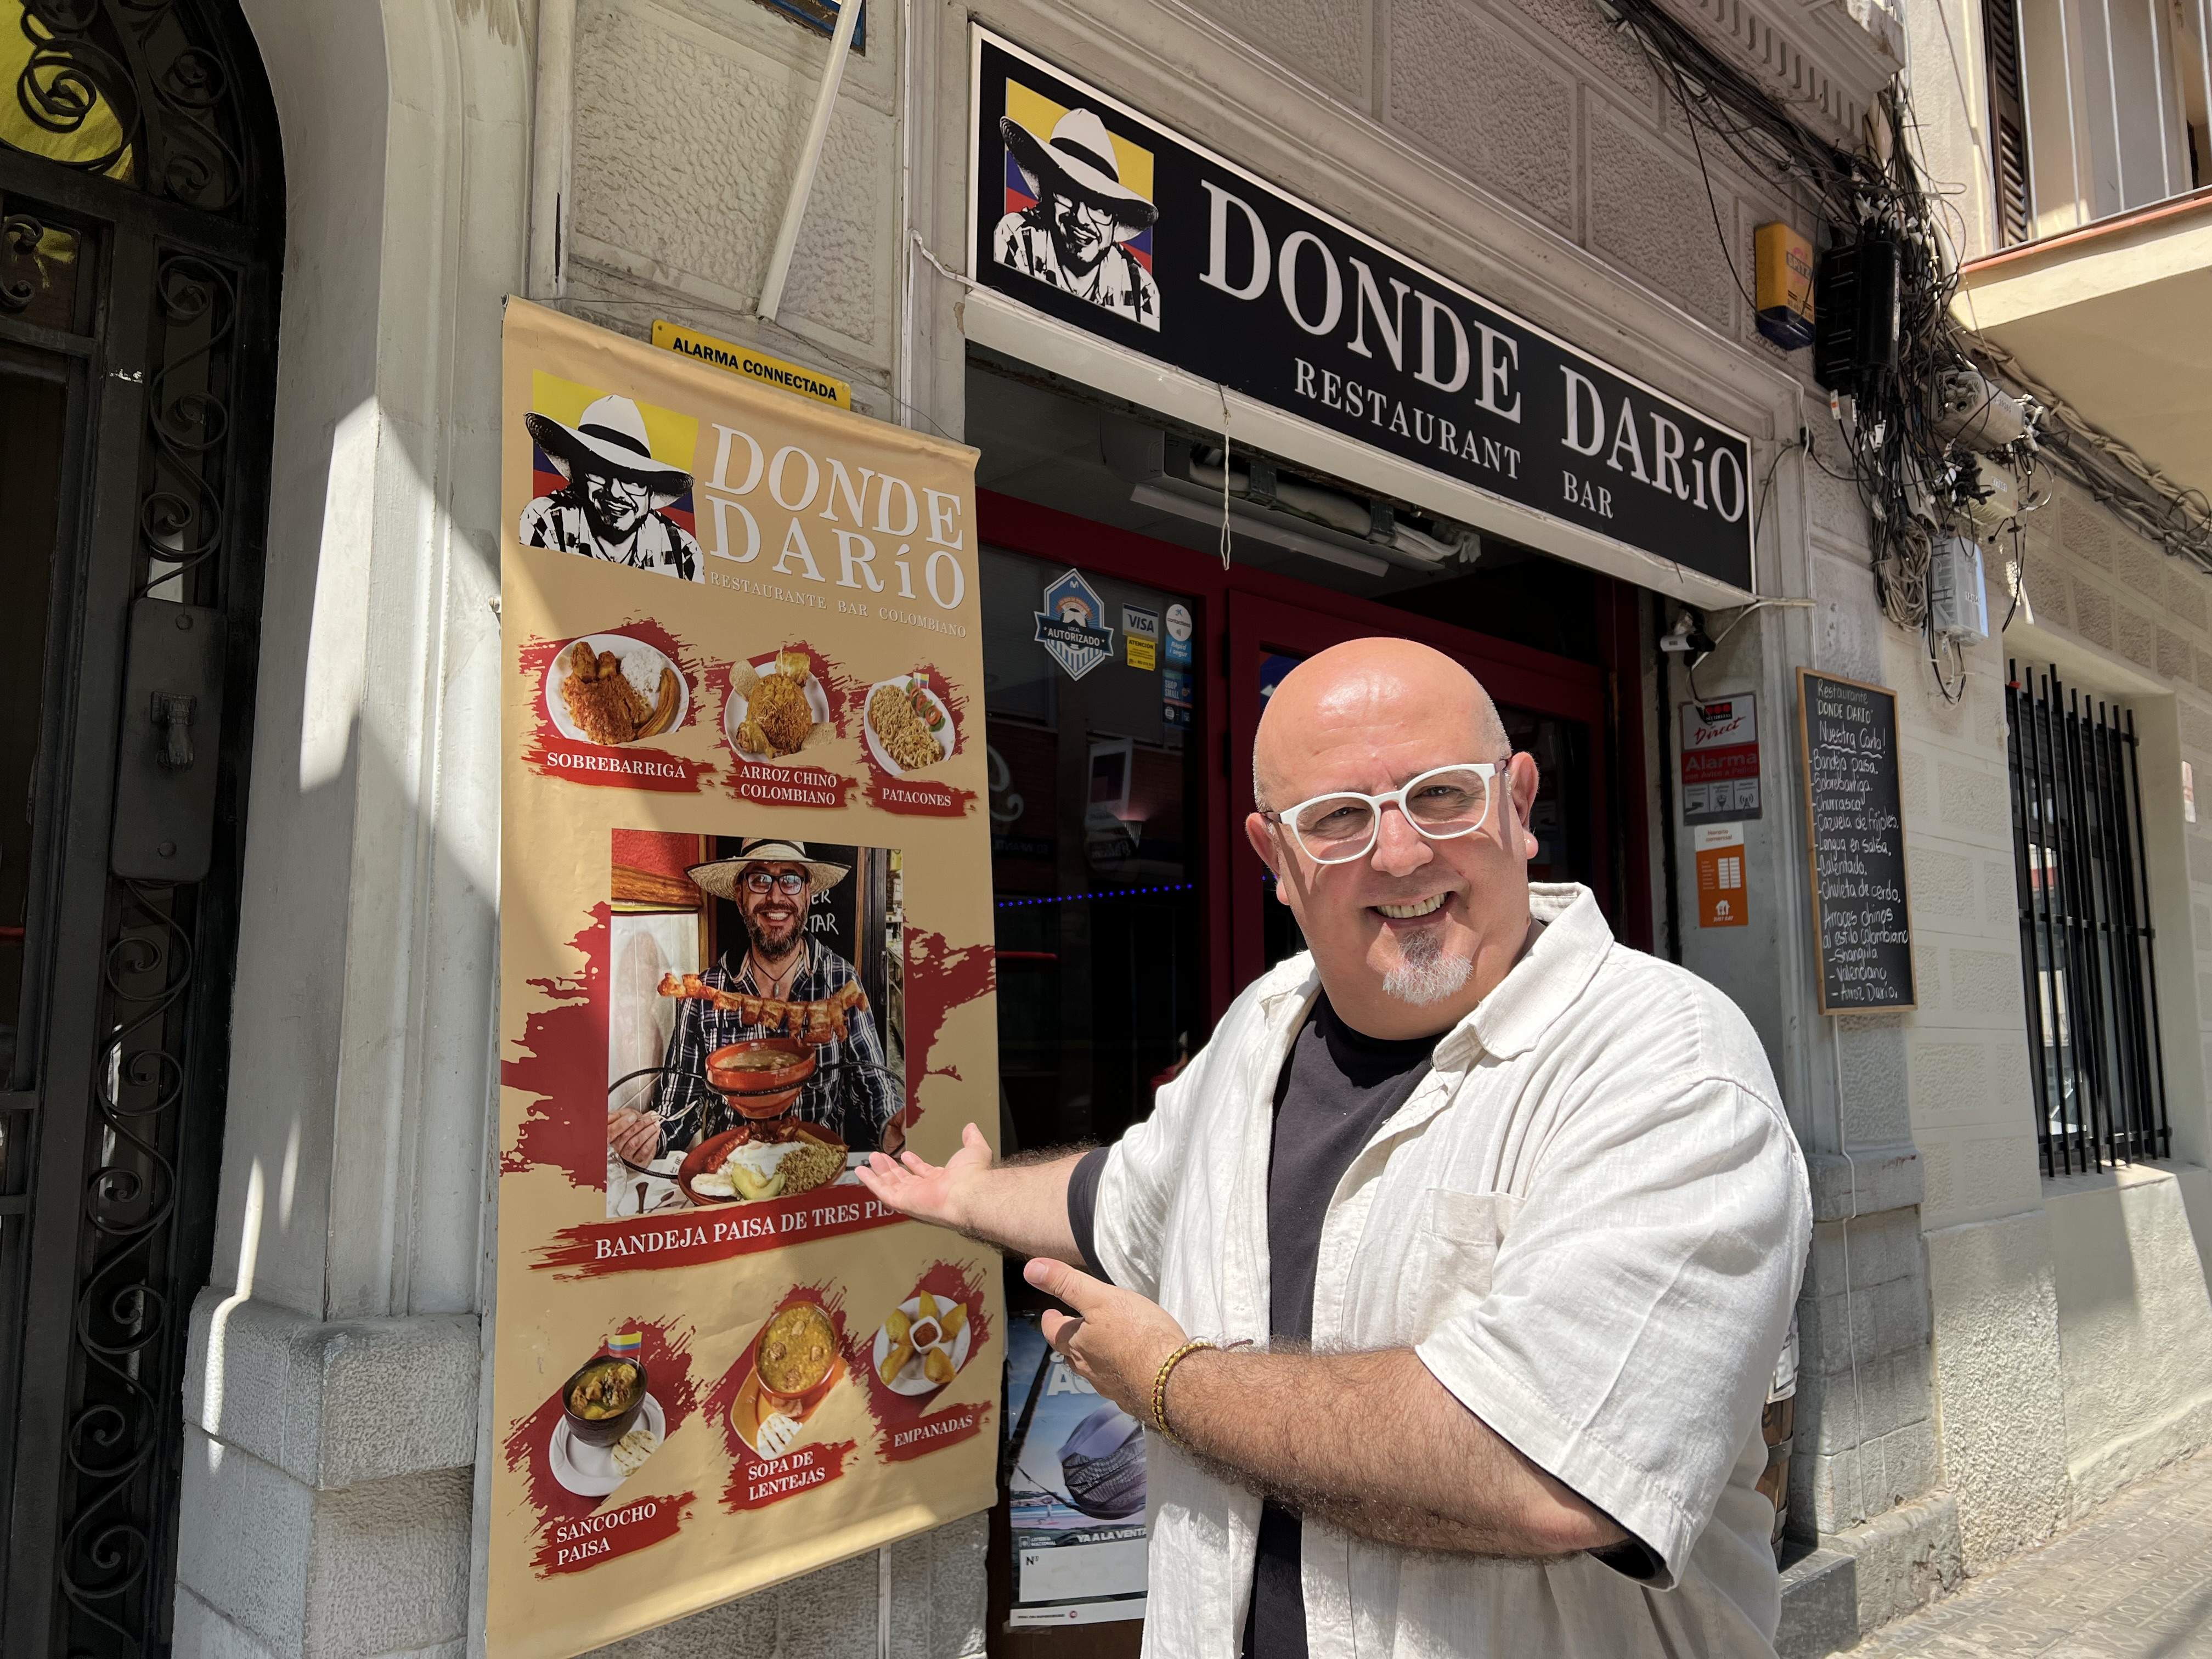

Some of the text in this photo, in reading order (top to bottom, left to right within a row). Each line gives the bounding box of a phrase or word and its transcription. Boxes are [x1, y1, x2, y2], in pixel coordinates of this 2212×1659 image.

[1199, 178, 1521, 424] DONDE
[673, 337, 837, 400] ALARMA CONNECTADA
[1294, 358, 1613, 519] RESTAURANT BAR
[706, 423, 963, 550] DONDE
[710, 572, 966, 638] RESTAURANTE BAR COLOMBIANO
[1047, 628, 1100, 646] AUTORIZADO
[1127, 613, 1154, 633] VISA
[1165, 680, 1177, 689] SHOP
[1165, 689, 1179, 699] SMALL
[1817, 679, 1868, 704] Restaurante
[1694, 716, 1746, 744] Direct
[1820, 720, 1857, 749] Nuestra
[547, 752, 686, 778] SOBREBARRIGA
[1685, 753, 1757, 772] Alarma
[1814, 748, 1847, 778] Bandeja
[741, 766, 838, 788] ARROZ CHINO
[741, 783, 836, 805] COLOMBIANO
[882, 788, 952, 807] PATACONES
[1855, 814, 1867, 831] de
[1819, 832, 1846, 861] Lengua
[1850, 838, 1860, 853] en
[1821, 877, 1857, 900] Chuleta
[1858, 878, 1869, 898] de
[1823, 931, 1832, 949] al
[595, 1230, 708, 1260] BANDEJA
[713, 1218, 776, 1243] PAISA
[781, 1213, 808, 1232] DE
[811, 1205, 860, 1228] TRES
[894, 1414, 973, 1448] EMPANADAS
[748, 1451, 814, 1481] SOPA DE
[748, 1468, 825, 1501] LENTEJAS
[556, 1503, 656, 1543] SANCOCHO
[1077, 1534, 1091, 1543] YA
[1092, 1533, 1100, 1542] A
[1101, 1532, 1115, 1540] LA
[557, 1538, 611, 1566] PAISA
